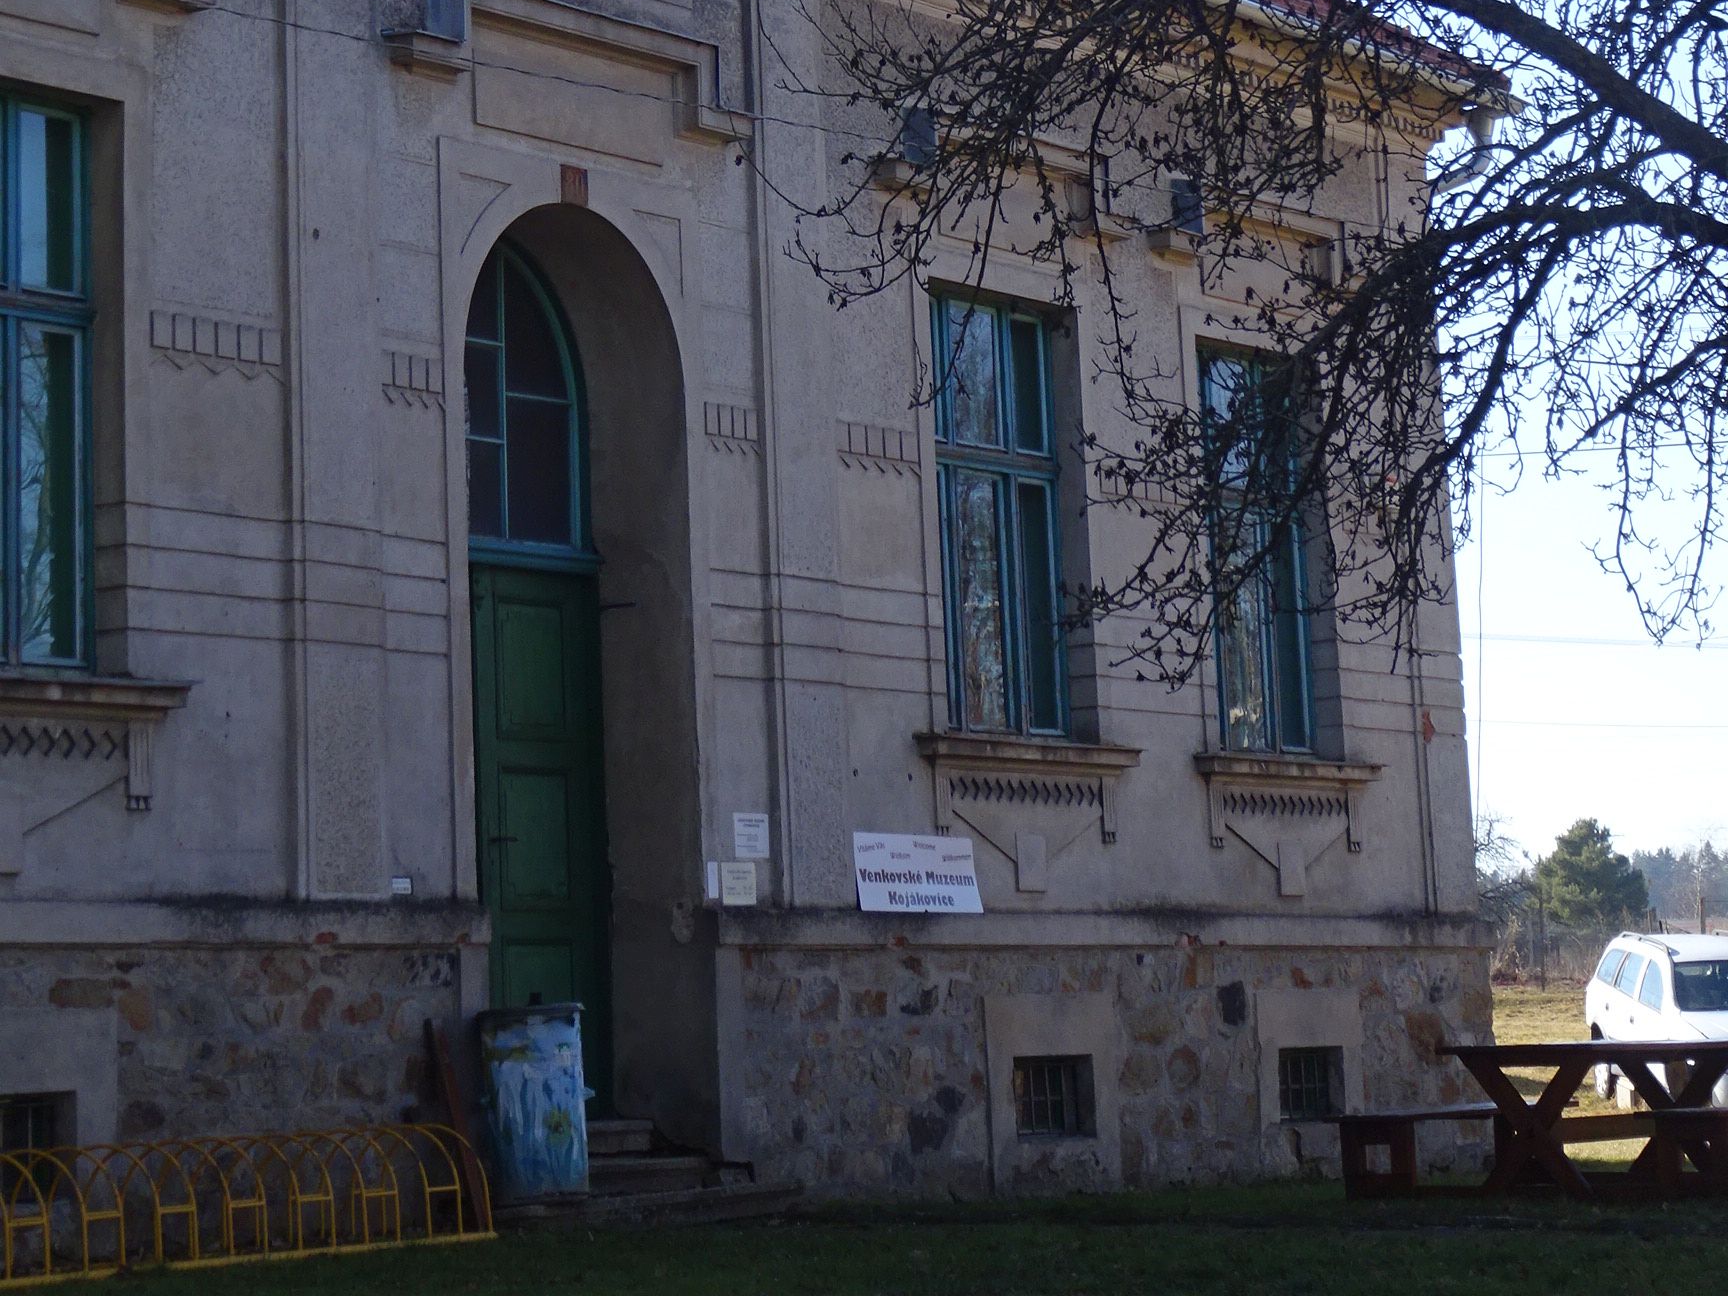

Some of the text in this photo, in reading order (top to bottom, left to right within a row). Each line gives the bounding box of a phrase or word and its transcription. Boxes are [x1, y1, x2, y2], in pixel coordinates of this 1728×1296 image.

[859, 868, 975, 886] Venkovské Muzeum
[888, 890, 955, 908] Kojákovice
